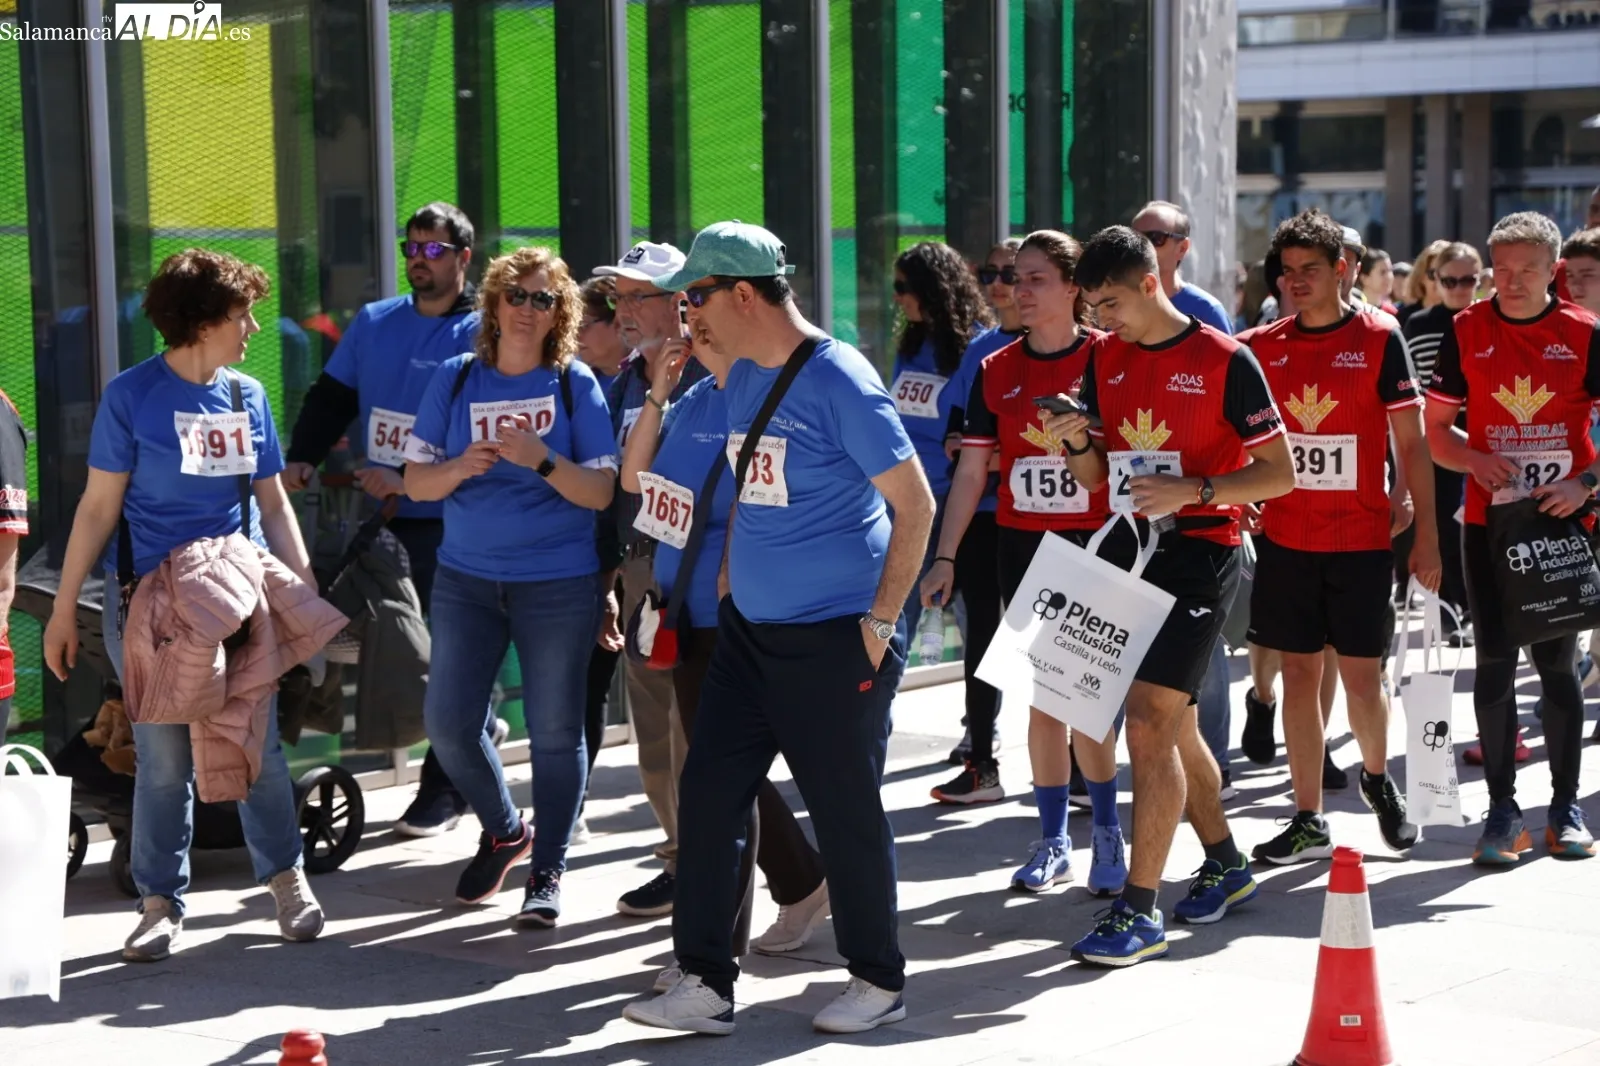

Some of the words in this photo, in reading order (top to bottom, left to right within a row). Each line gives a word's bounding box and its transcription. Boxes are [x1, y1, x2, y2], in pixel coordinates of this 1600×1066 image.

[1335, 351, 1365, 362] ADAS
[1165, 383, 1179, 391] Club
[1180, 385, 1206, 394] Deportivo
[1170, 372, 1204, 387] ADAS
[897, 380, 934, 404] 550
[181, 427, 245, 458] 1691
[1485, 424, 1519, 440] CAJA
[1520, 422, 1569, 438] RURAL
[1500, 438, 1569, 451] SALAMANCA
[735, 451, 774, 485] 53
[1292, 446, 1342, 475] 391
[1020, 468, 1078, 498] 158
[645, 486, 691, 532] 1667
[1531, 535, 1583, 559] Plena
[1538, 551, 1588, 570] inclusión
[1543, 569, 1574, 582] Castilla
[1521, 601, 1547, 611] CASTILLA
[1065, 600, 1130, 647] Plena
[1059, 620, 1121, 659] inclusión
[1053, 635, 1088, 660] Castilla
[1097, 656, 1122, 676] León
[1049, 664, 1065, 675] LEÓN
